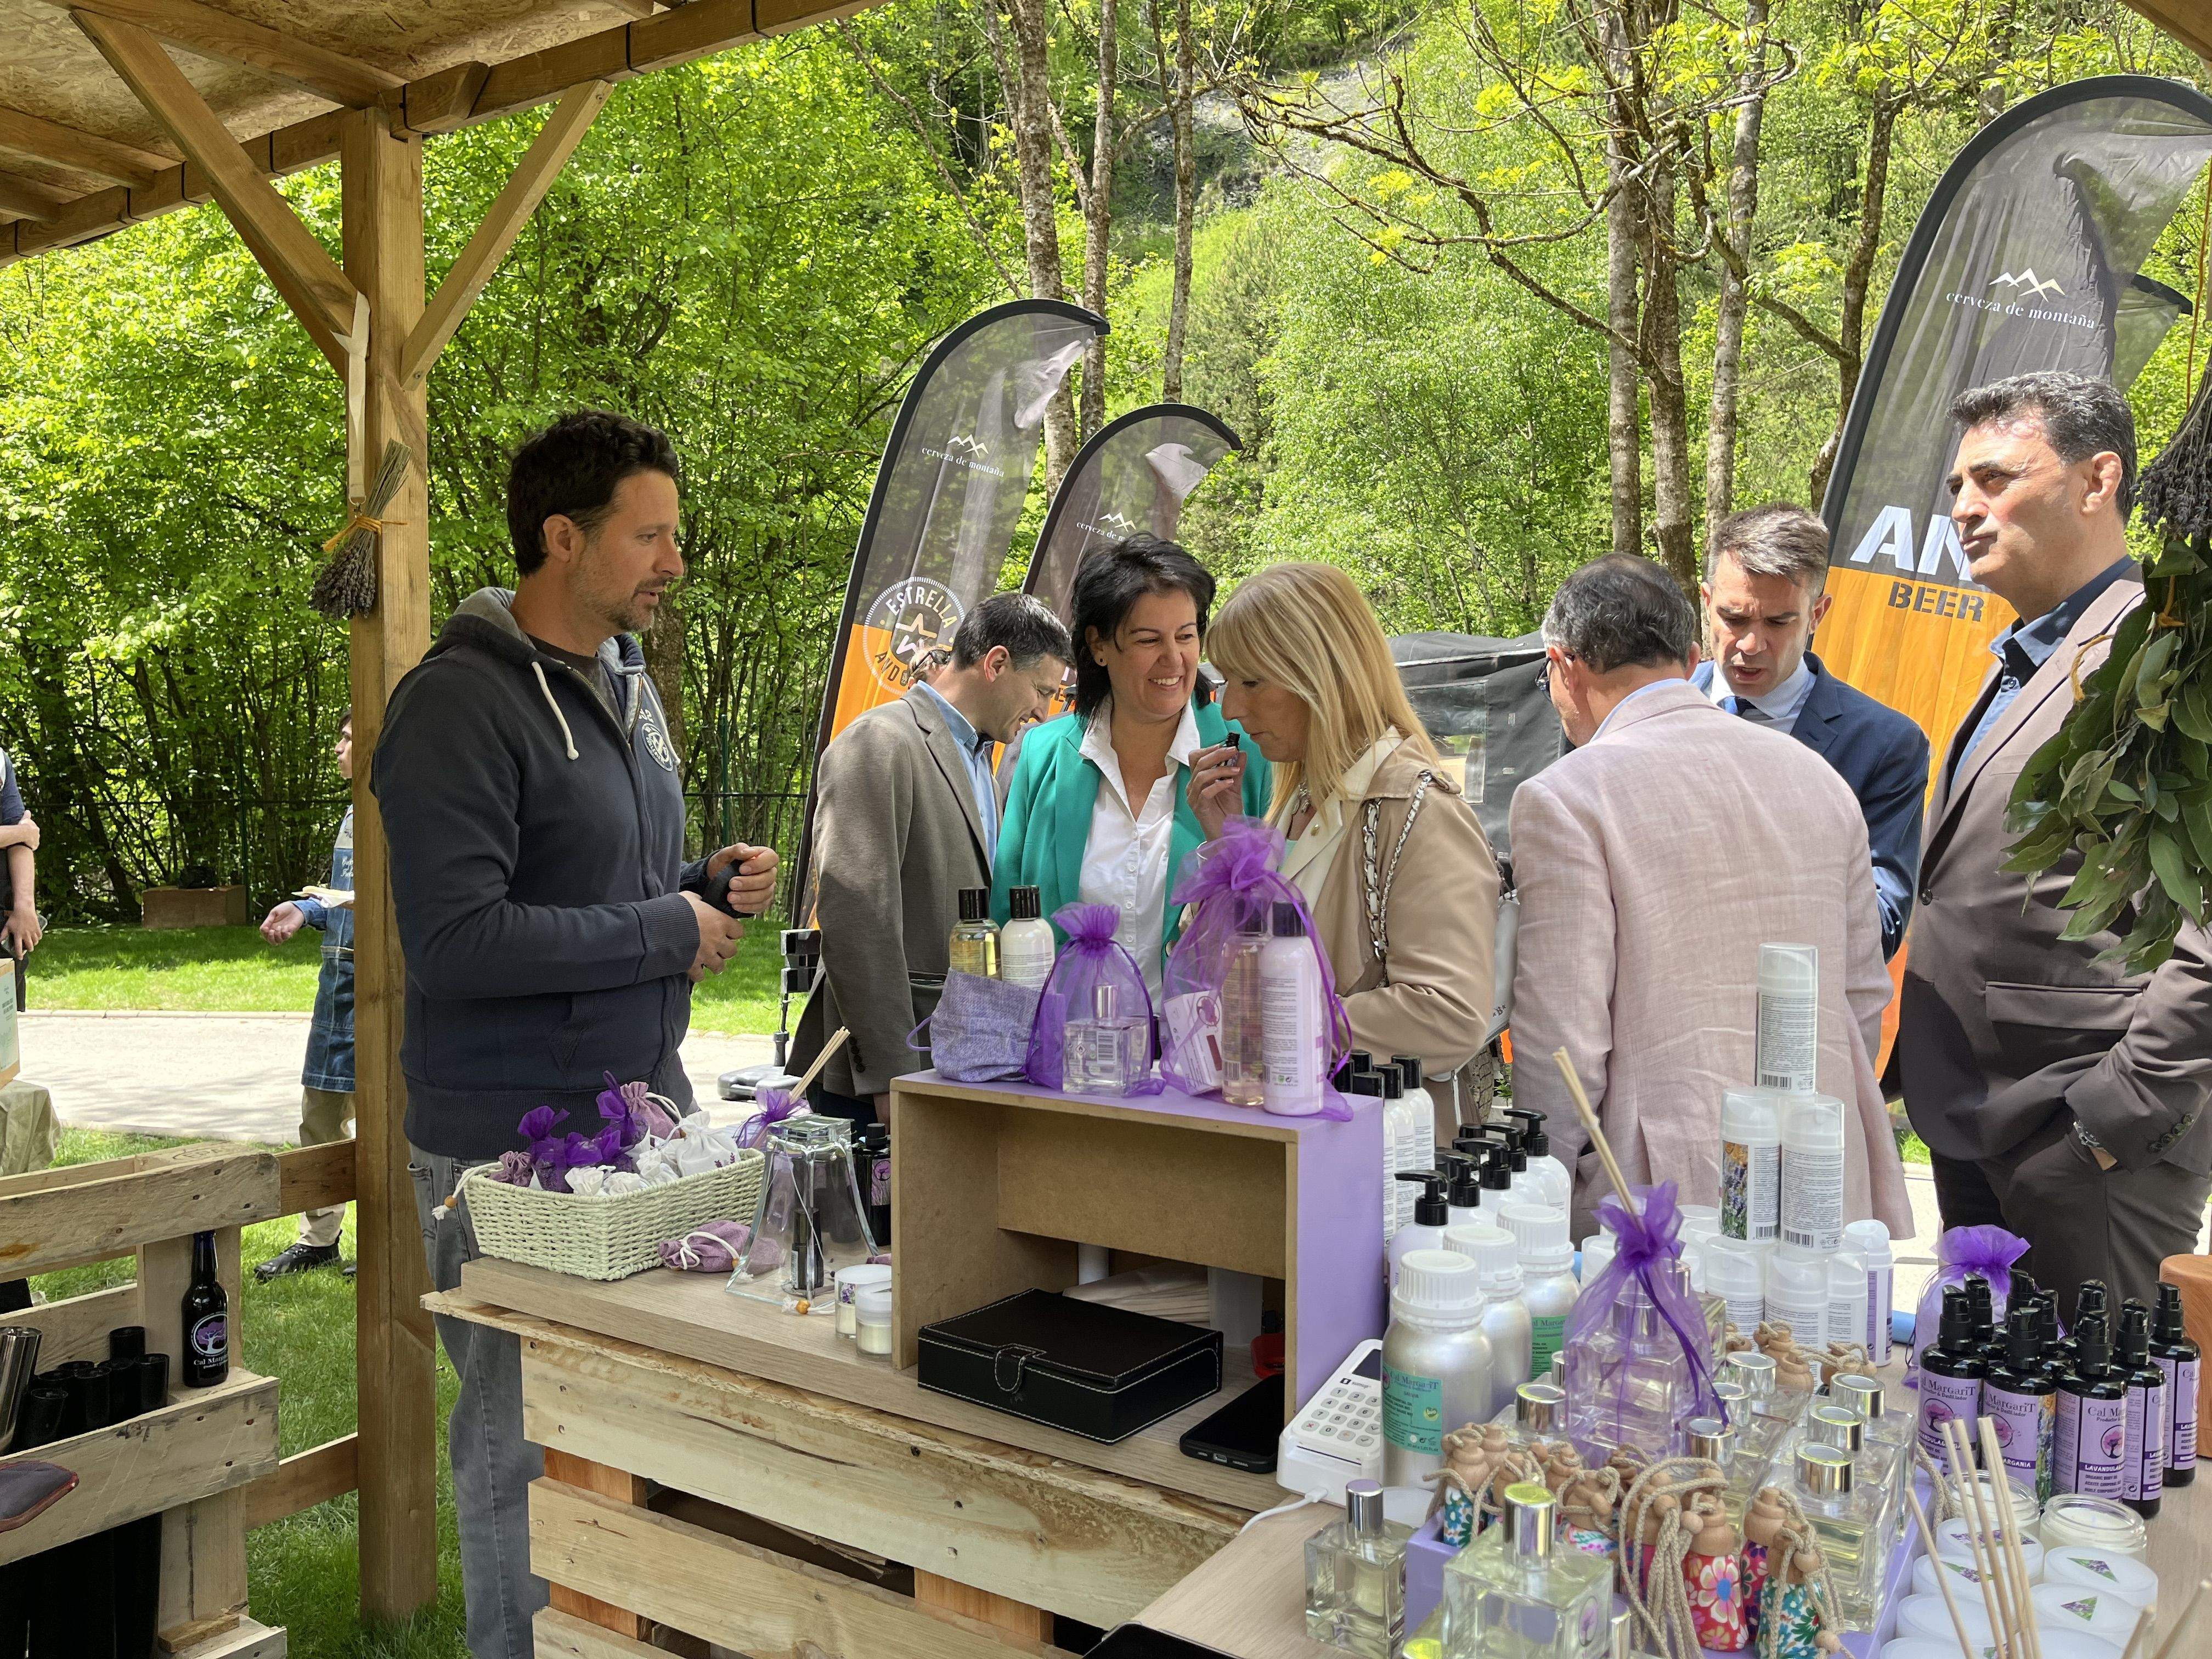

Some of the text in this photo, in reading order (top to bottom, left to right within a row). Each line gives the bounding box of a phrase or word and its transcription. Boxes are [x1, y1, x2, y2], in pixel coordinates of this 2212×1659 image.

[1946, 292, 2095, 329] cerveza de montaña
[922, 447, 1005, 477] cerveza de montaña
[1076, 522, 1105, 536] cerveza
[1107, 530, 1117, 539] de
[1849, 505, 1972, 582] AN
[885, 586, 958, 628] ESTRELLA
[1888, 582, 1985, 622] BEER
[2087, 1406, 2106, 1417] Cal
